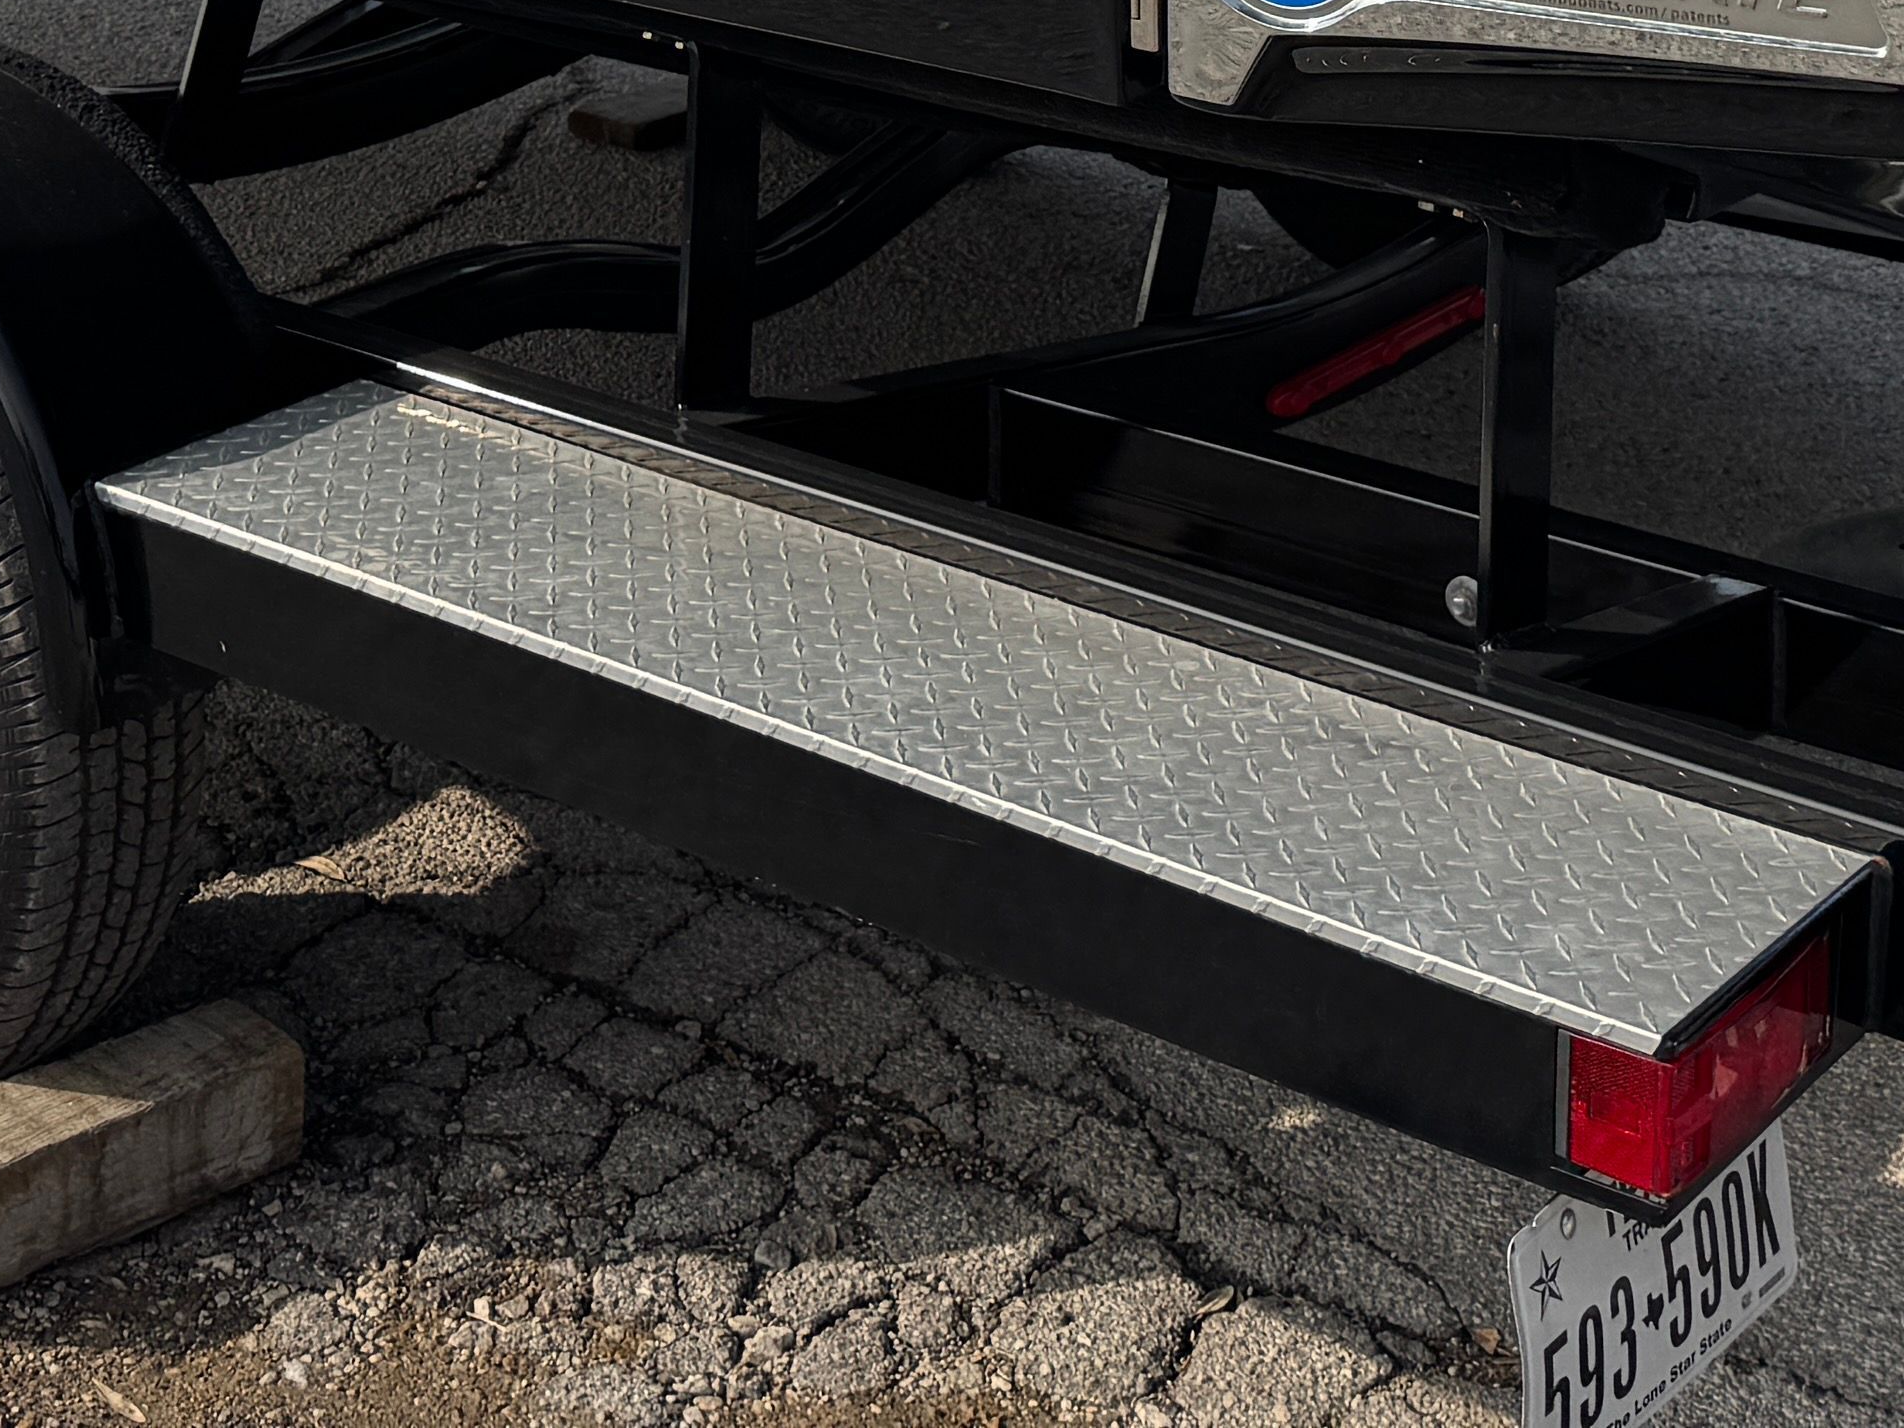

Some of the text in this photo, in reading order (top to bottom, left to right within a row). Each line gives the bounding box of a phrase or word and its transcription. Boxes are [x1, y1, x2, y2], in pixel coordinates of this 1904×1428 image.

[1634, 1380, 1668, 1419] Lone
[1669, 1352, 1698, 1386] Star
[1699, 1317, 1734, 1357] State
